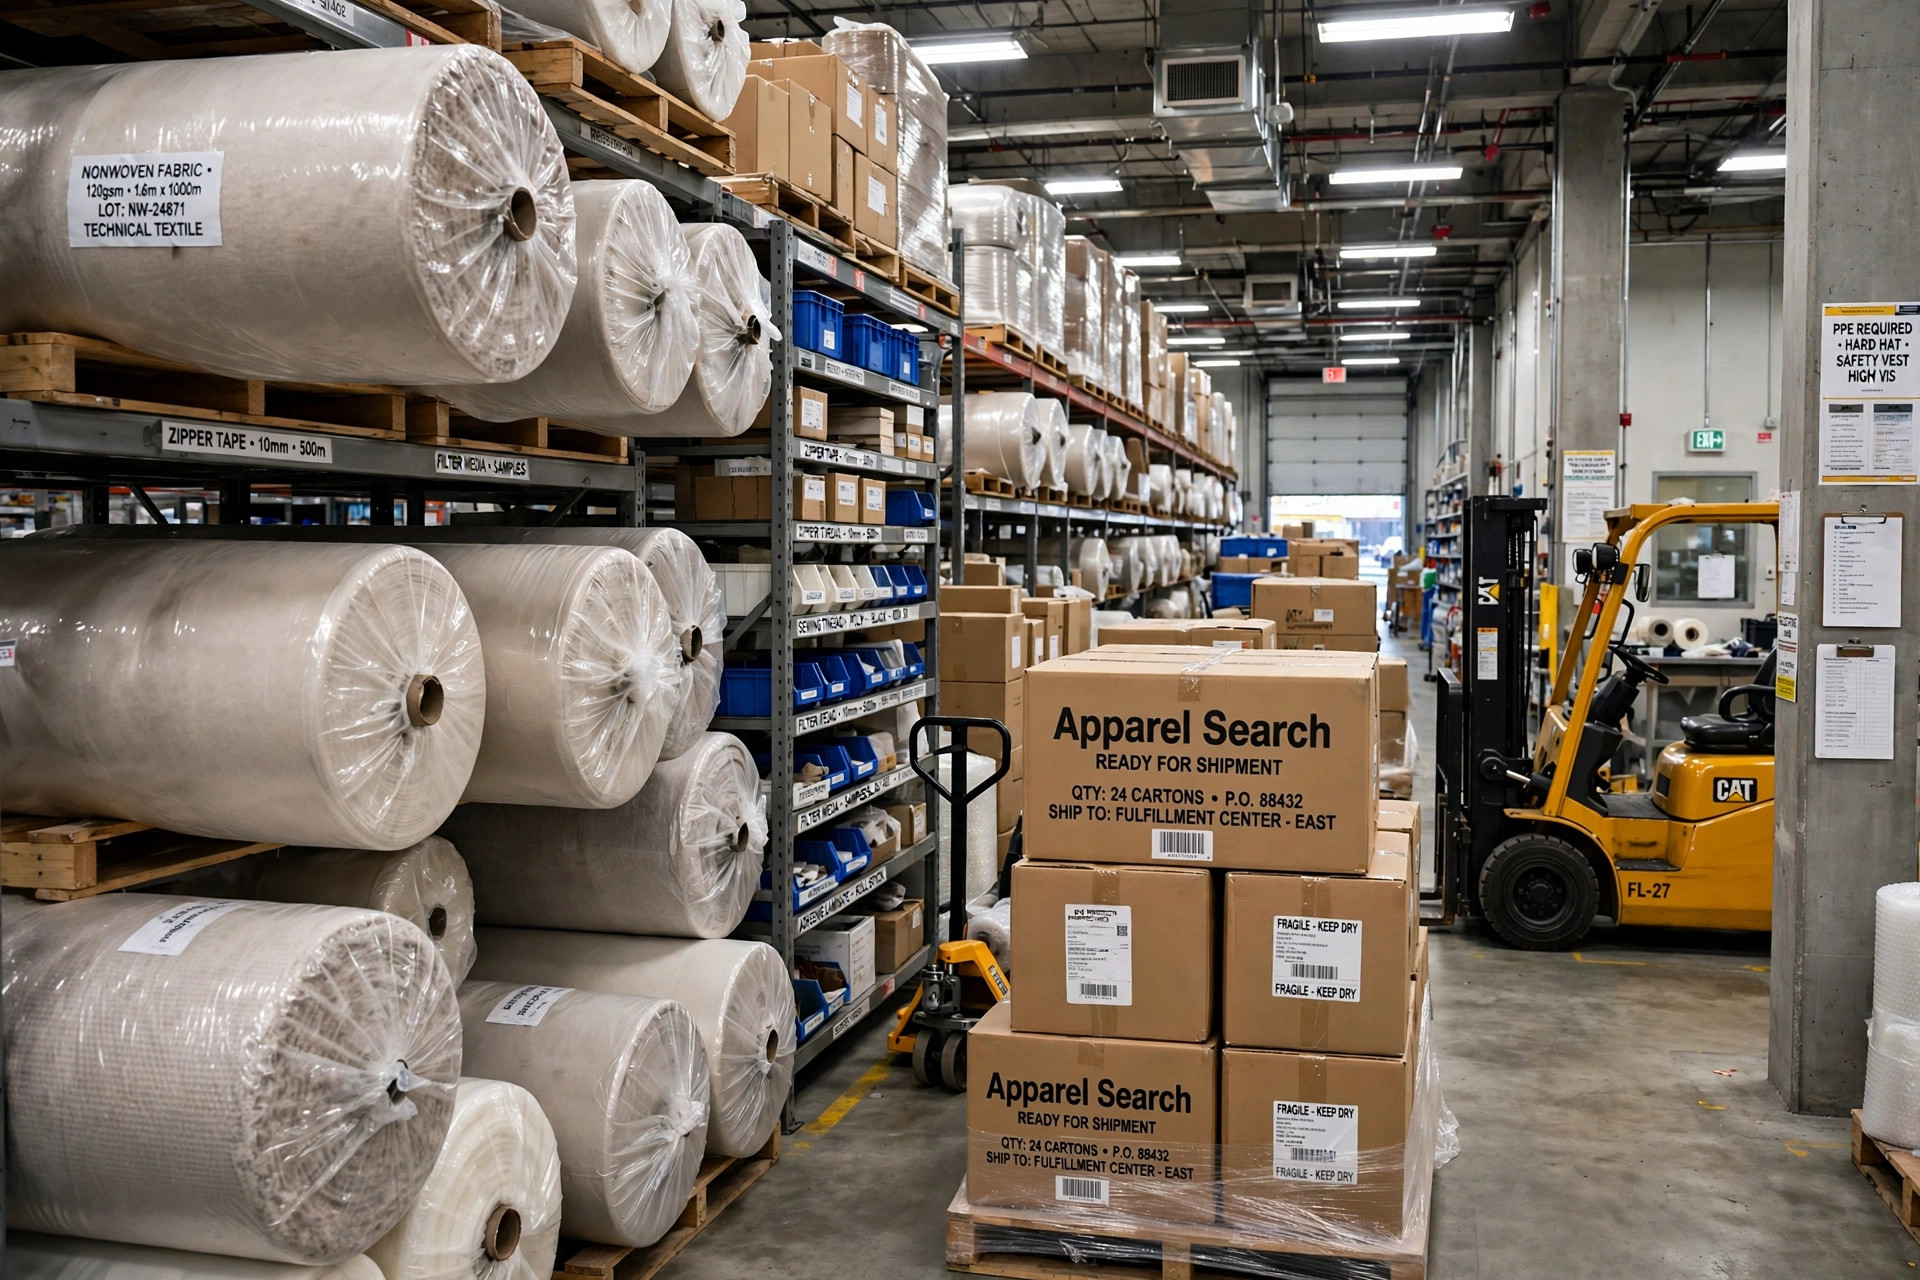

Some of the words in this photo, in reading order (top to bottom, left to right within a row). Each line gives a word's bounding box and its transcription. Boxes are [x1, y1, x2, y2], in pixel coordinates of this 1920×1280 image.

[82, 165, 154, 179] NONWOVEN
[158, 163, 203, 177] FABRIC
[87, 184, 123, 200] 120gsm
[134, 183, 157, 197] 1.6m
[160, 186, 166, 196] x
[169, 182, 202, 196] 1000m
[98, 204, 125, 217] LOT:
[128, 202, 185, 216] NW-24871
[84, 223, 152, 237] TECHNICAL
[154, 222, 203, 237] TEXTILE
[1833, 322, 1854, 335] PPE
[1856, 322, 1913, 335] REQUIRED
[1845, 338, 1876, 351] HARD
[1879, 338, 1902, 351] HAT
[1836, 354, 1879, 367] SAFETY
[1881, 354, 1909, 367] VEST
[1848, 369, 1876, 383] HIGH
[1879, 369, 1896, 383] VIS
[168, 427, 213, 448] ZIPPER
[216, 432, 246, 450] TAPE
[258, 436, 289, 454] 10mm
[299, 440, 326, 457] 500m
[1053, 706, 1191, 750] Apparel
[1202, 709, 1331, 749] Search
[1096, 753, 1152, 771] READY
[1157, 755, 1192, 773] FOR
[1196, 757, 1283, 775] SHIPMENT
[1071, 785, 1106, 802] QTY:
[1110, 786, 1127, 802] 24
[1131, 787, 1204, 805] CARTONS
[1225, 791, 1254, 807] P.O.
[1259, 792, 1303, 809] 88432
[1717, 779, 1753, 802] CAT
[1048, 804, 1082, 820] SHIP
[1086, 805, 1111, 822] TO:
[1116, 807, 1215, 826] FULFILLMENT
[1219, 811, 1281, 828] CENTER
[1295, 814, 1336, 830] EAST
[1627, 882, 1671, 898] FL-27
[1277, 918, 1311, 931] FRAGILE
[1318, 921, 1339, 933] KEEP
[1341, 922, 1358, 934] DRY
[1275, 983, 1309, 996] FRAGILE
[1316, 986, 1337, 998] KEEP
[1339, 987, 1357, 999] DRY
[986, 1071, 1089, 1108] Apparel
[1097, 1078, 1191, 1114] Search
[1277, 1103, 1310, 1116] FRAGILE
[1316, 1106, 1337, 1117] KEEP
[1338, 1107, 1354, 1119] DRY
[1017, 1111, 1060, 1127] READY
[1063, 1115, 1089, 1129] FOR
[1092, 1116, 1156, 1134] SHIPMENT
[1001, 1136, 1027, 1151] QTY:
[1029, 1139, 1041, 1152] 24
[1044, 1140, 1098, 1157] CARTONS
[1112, 1145, 1135, 1159] P.O.
[986, 1151, 1010, 1165] SHIP
[1013, 1153, 1032, 1167] TO:
[1034, 1155, 1106, 1173] FULFILLMENT
[1109, 1161, 1155, 1177] CENTER
[1165, 1166, 1194, 1180] EAST
[1276, 1166, 1308, 1179] FRAGILE
[1315, 1169, 1335, 1181] KEEP
[1337, 1170, 1354, 1182] DRY
